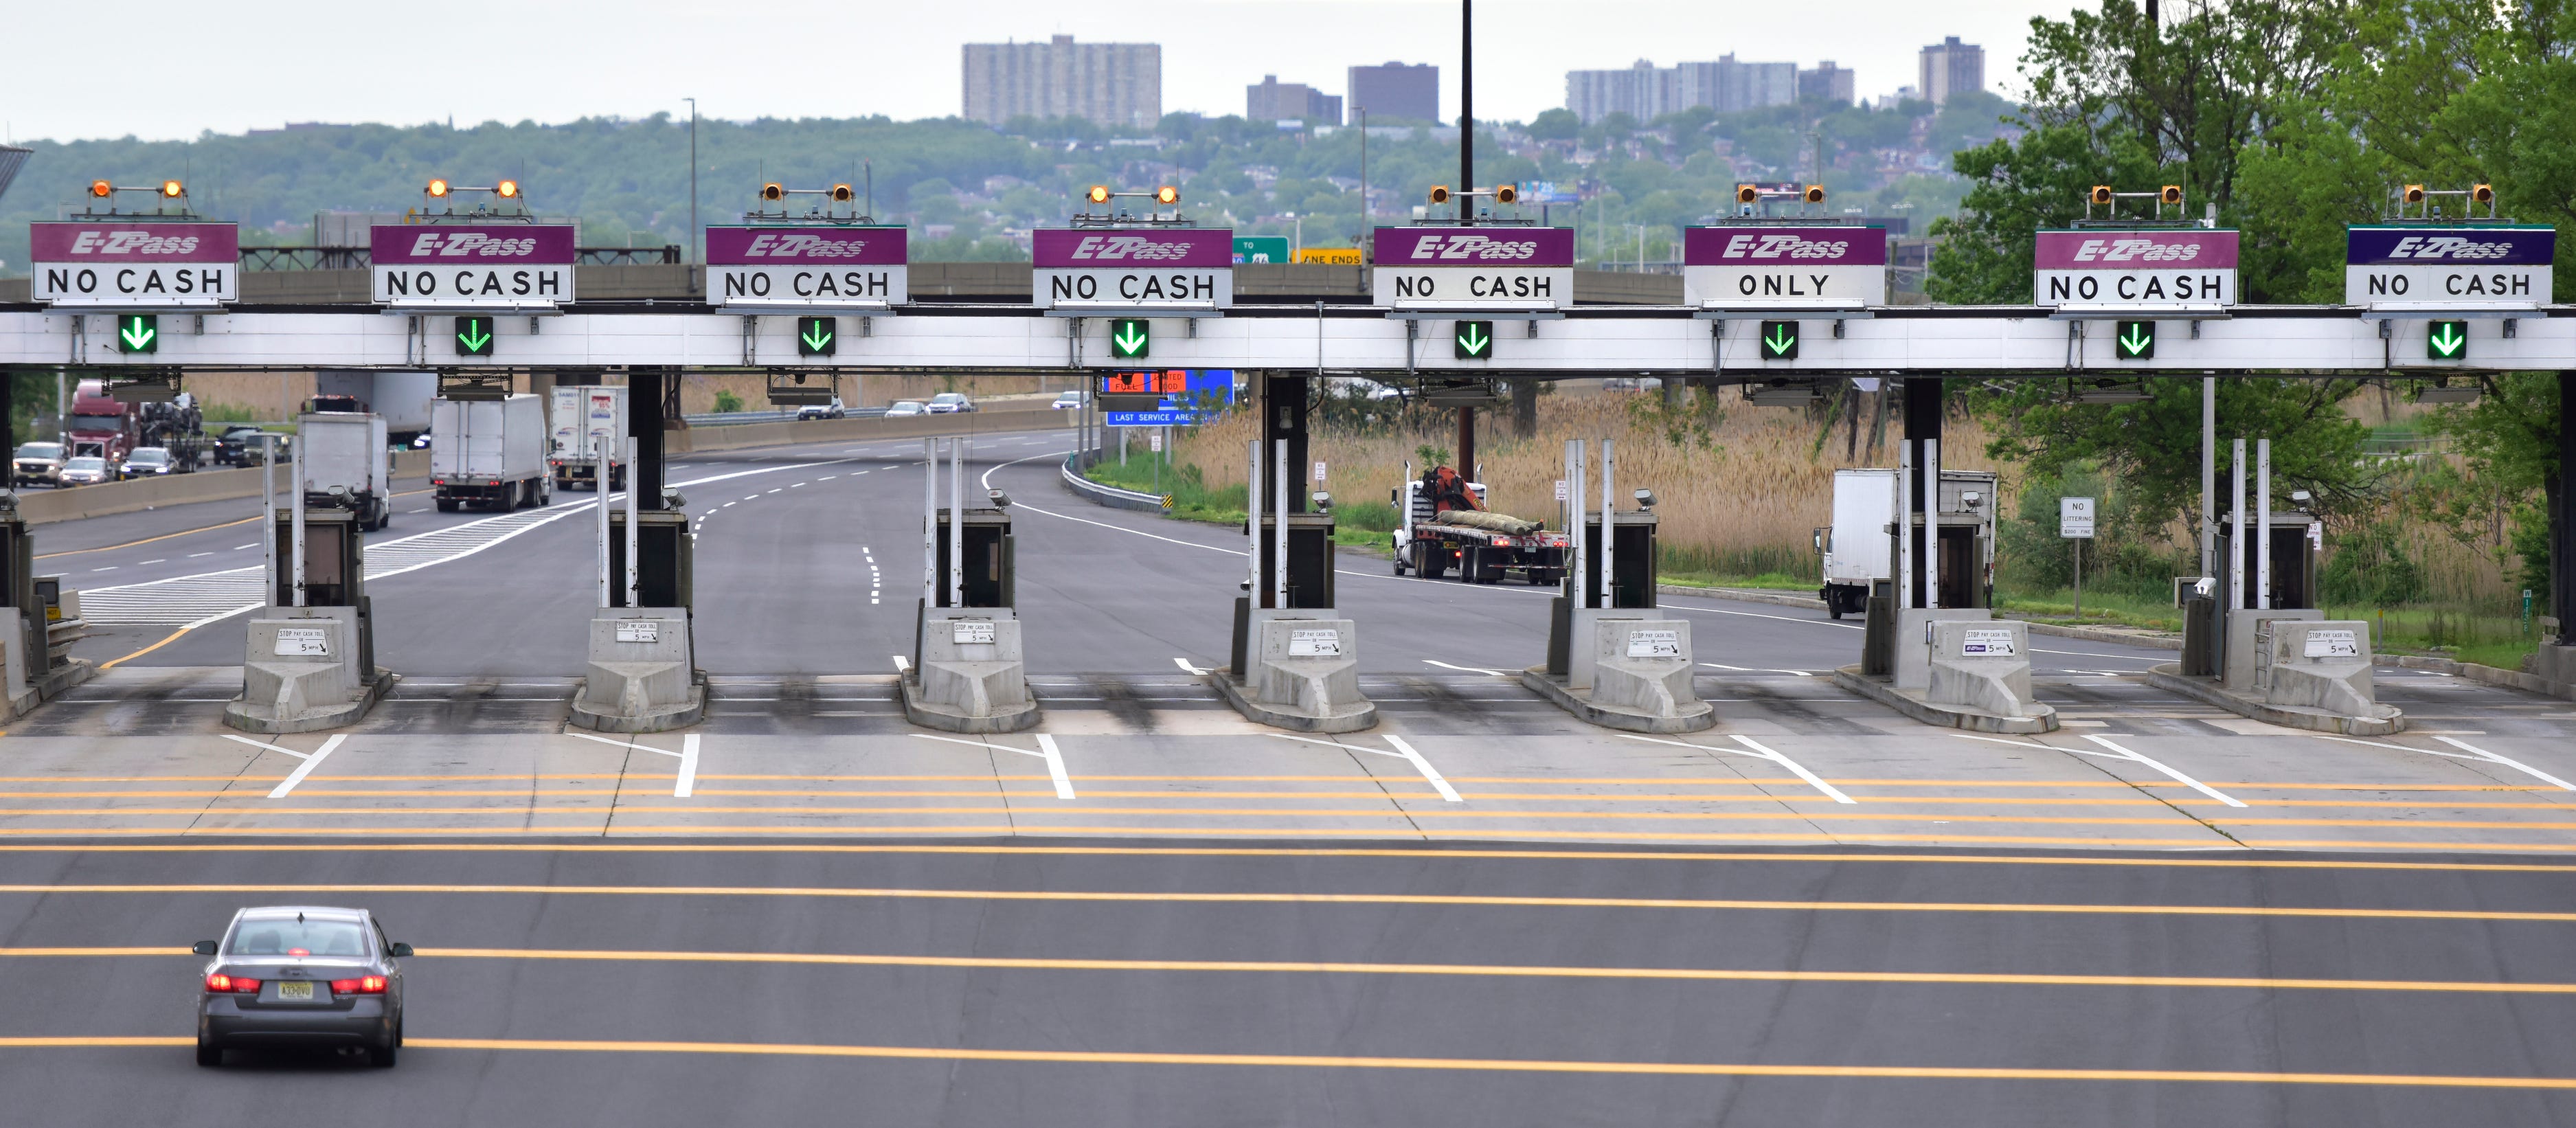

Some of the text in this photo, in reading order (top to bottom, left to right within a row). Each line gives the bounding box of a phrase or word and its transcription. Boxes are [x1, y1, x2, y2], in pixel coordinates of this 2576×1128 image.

[71, 232, 199, 253] E-ZPass
[410, 234, 536, 256] E-ZPass
[745, 235, 865, 257] E-ZPass
[1071, 236, 1191, 259] E-ZPass
[1411, 236, 1537, 259] E-ZPass
[1723, 235, 1848, 258] E-ZPass
[2074, 239, 2200, 261] E-ZPass
[2388, 237, 2513, 259] E-ZPass
[1300, 256, 1360, 264] ANE ENDS
[49, 269, 221, 293] NO CASH
[388, 271, 558, 295] NO CASH
[726, 272, 887, 296] NO CASH
[1052, 275, 1212, 299] NO CASH
[1397, 276, 1550, 297] NO CASH
[1740, 275, 1829, 295] ONLY
[2051, 275, 2220, 300] NO CASH
[2370, 275, 2529, 295] NO CASH
